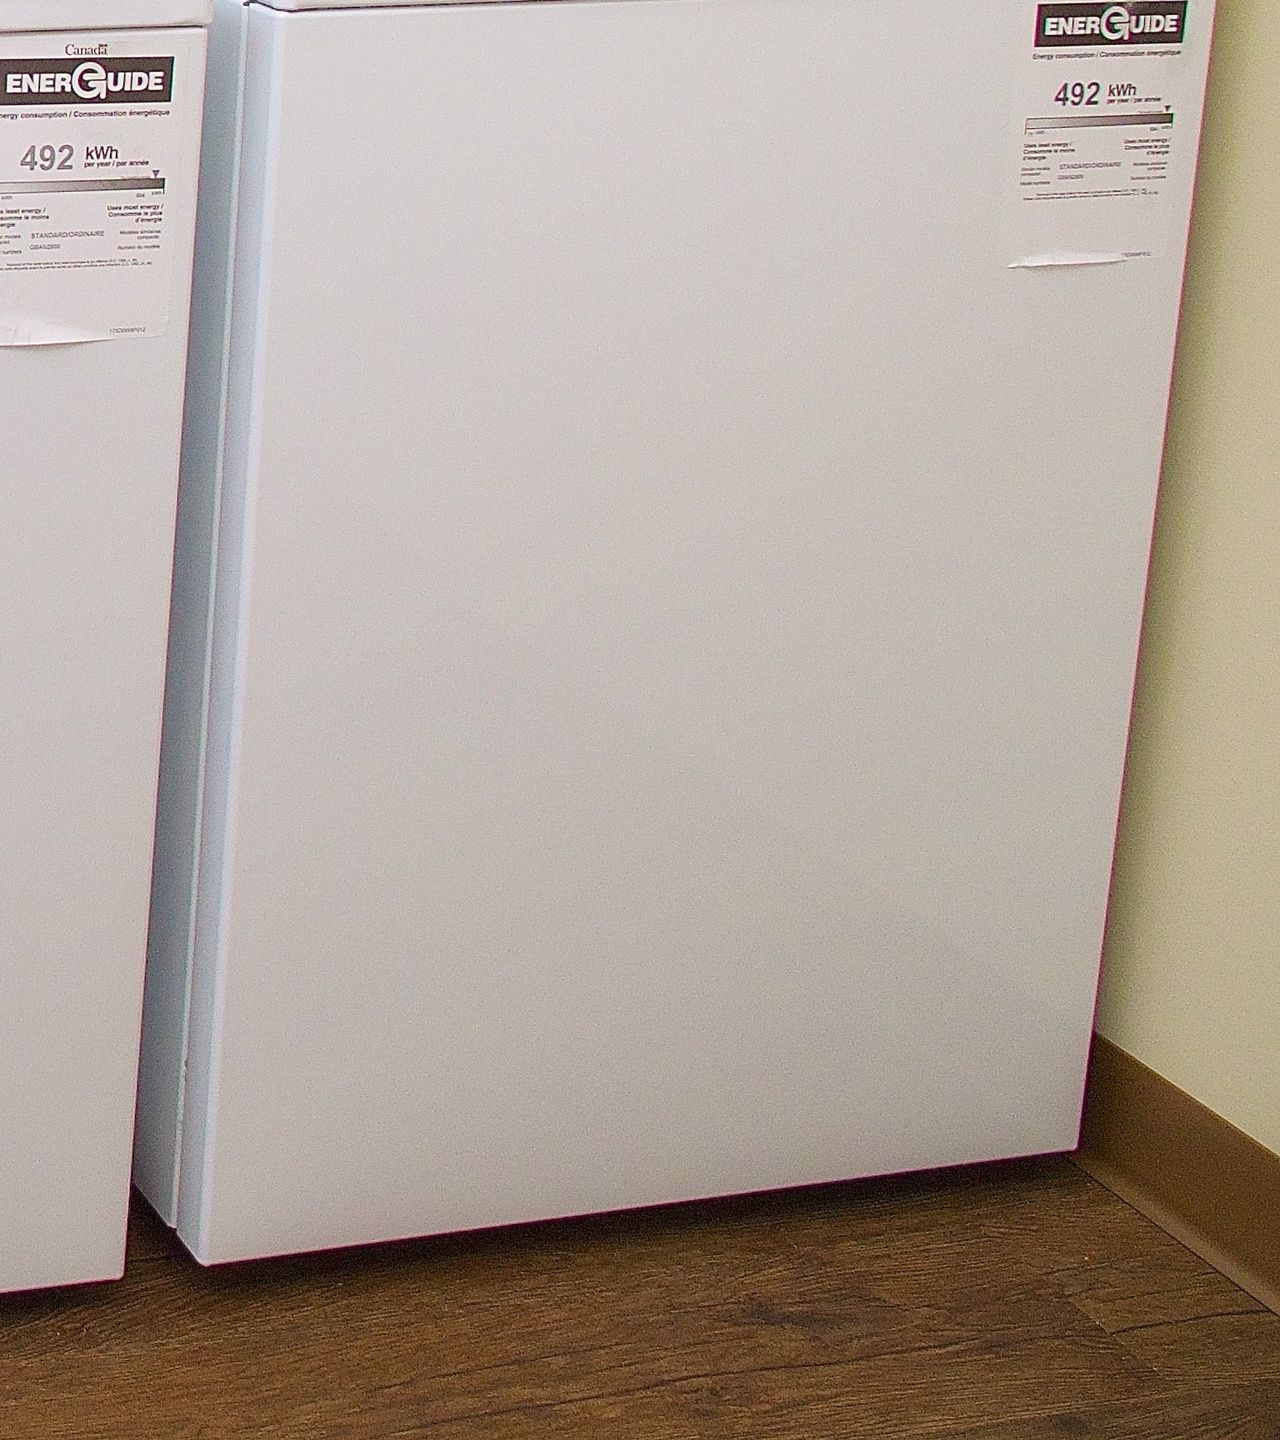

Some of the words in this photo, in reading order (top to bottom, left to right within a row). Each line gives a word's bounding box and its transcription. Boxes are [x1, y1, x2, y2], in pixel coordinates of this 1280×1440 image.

[1044, 5, 1180, 41] ENERGUIDE
[65, 43, 108, 56] Canada
[6, 61, 164, 100] ENERGUIDE
[1053, 82, 1101, 106] 492
[1107, 83, 1137, 97] kWh
[21, 111, 67, 119] consumption
[20, 144, 75, 171] 492
[85, 146, 119, 160] kWh
